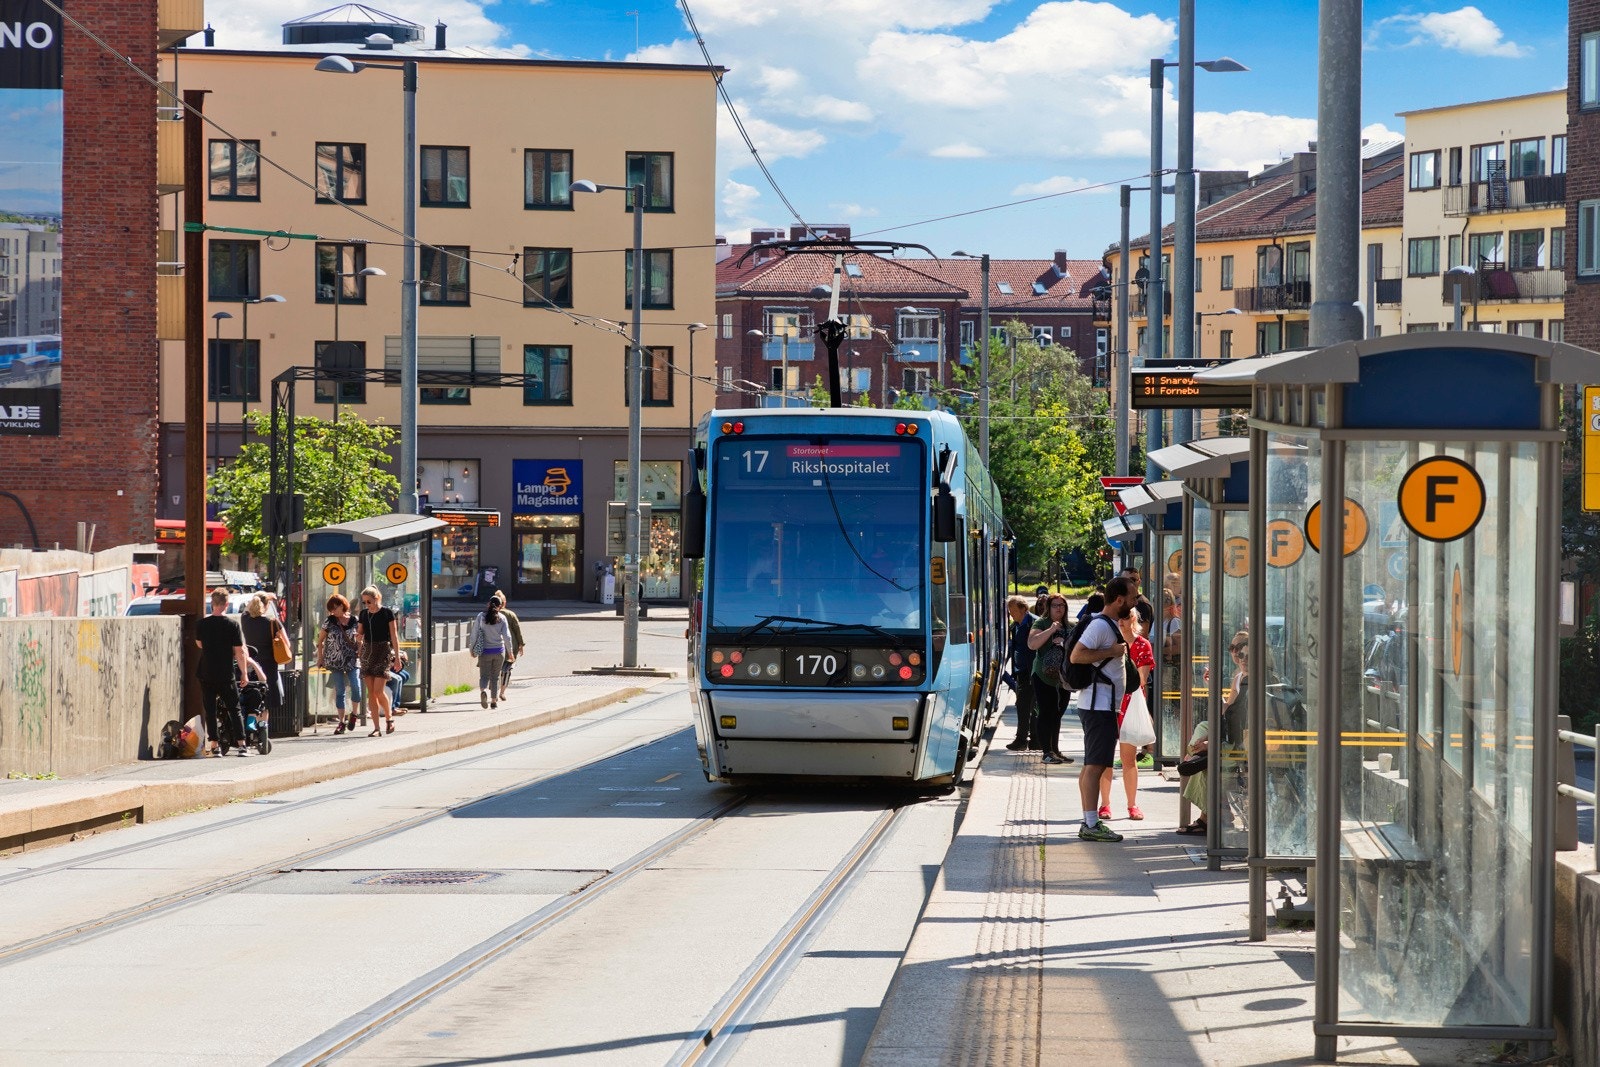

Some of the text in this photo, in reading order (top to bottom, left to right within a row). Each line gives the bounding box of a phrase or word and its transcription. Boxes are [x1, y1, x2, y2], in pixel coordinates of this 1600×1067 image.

[1144, 376, 1155, 385] 31
[1144, 386, 1200, 395] 31 Fornebu
[792, 447, 829, 455] Stortorvet
[742, 450, 769, 473] 17
[792, 461, 890, 476] Rikshospitalet
[517, 482, 557, 496] Lampe
[517, 494, 579, 508] Magasinet
[1425, 475, 1459, 522] F
[1271, 529, 1291, 558] F
[1193, 547, 1207, 566] E
[1230, 545, 1247, 569] F
[329, 567, 340, 581] C
[391, 567, 402, 580] C
[796, 654, 837, 676] 170
